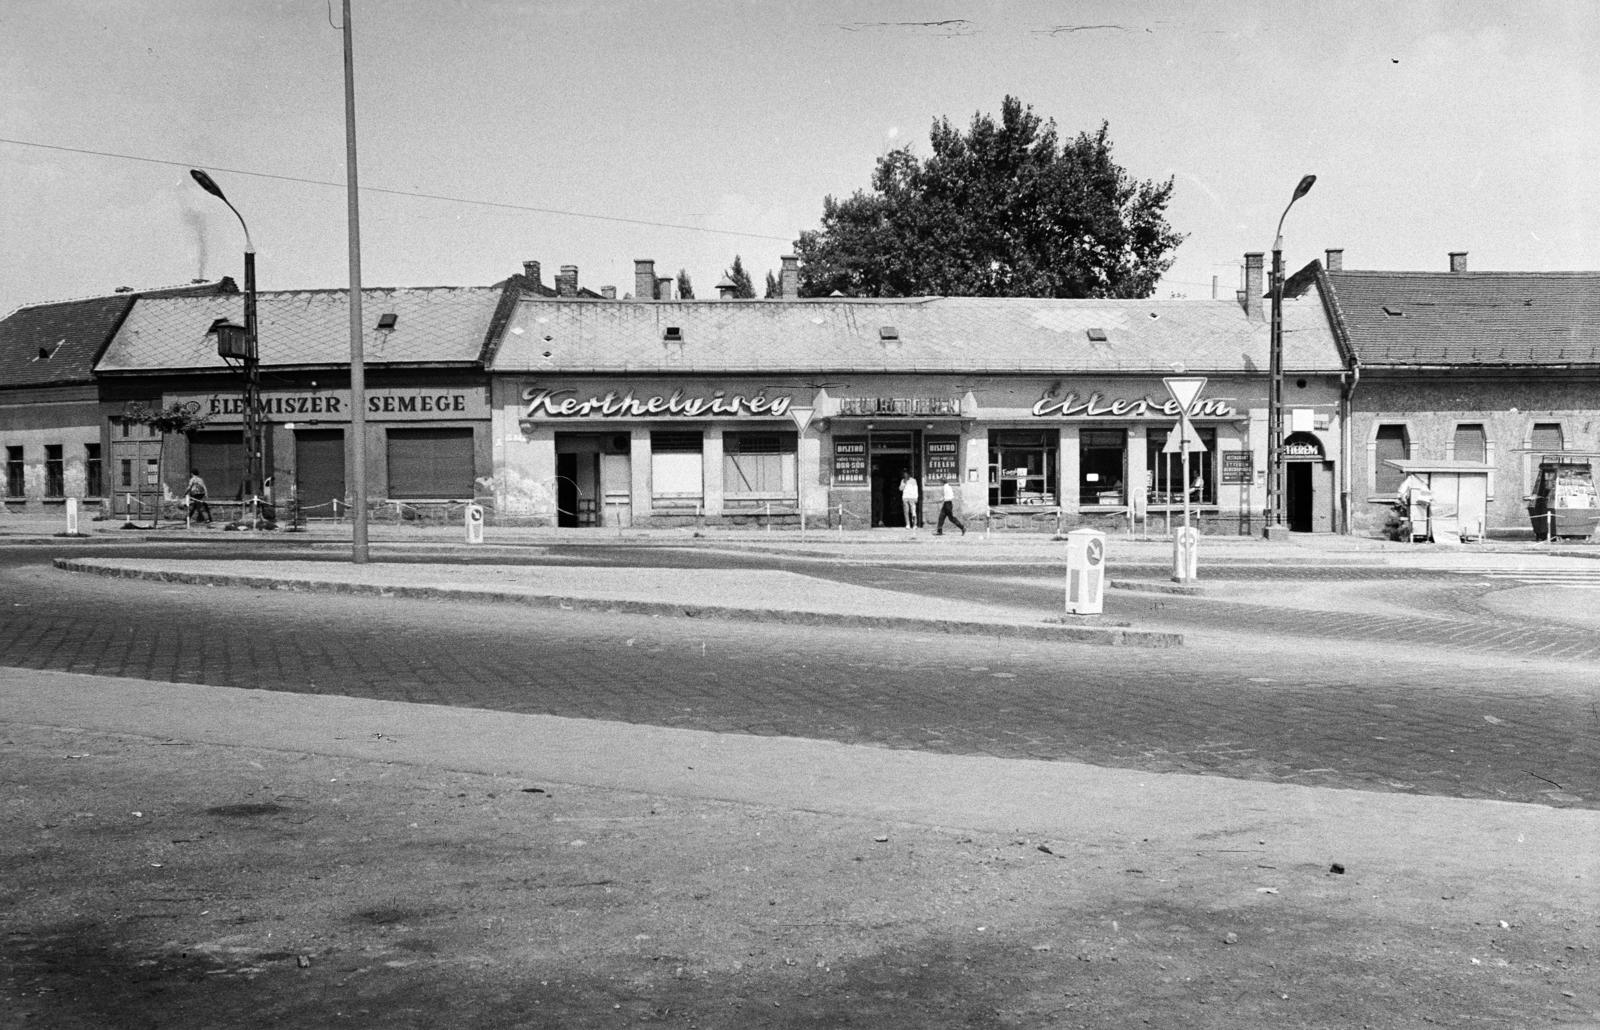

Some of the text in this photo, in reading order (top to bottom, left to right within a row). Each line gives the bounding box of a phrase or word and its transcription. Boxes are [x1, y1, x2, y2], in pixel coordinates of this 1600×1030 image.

[209, 394, 466, 415] ÉLEMISZER SEMEGE
[521, 386, 792, 418] Kerthelyiség
